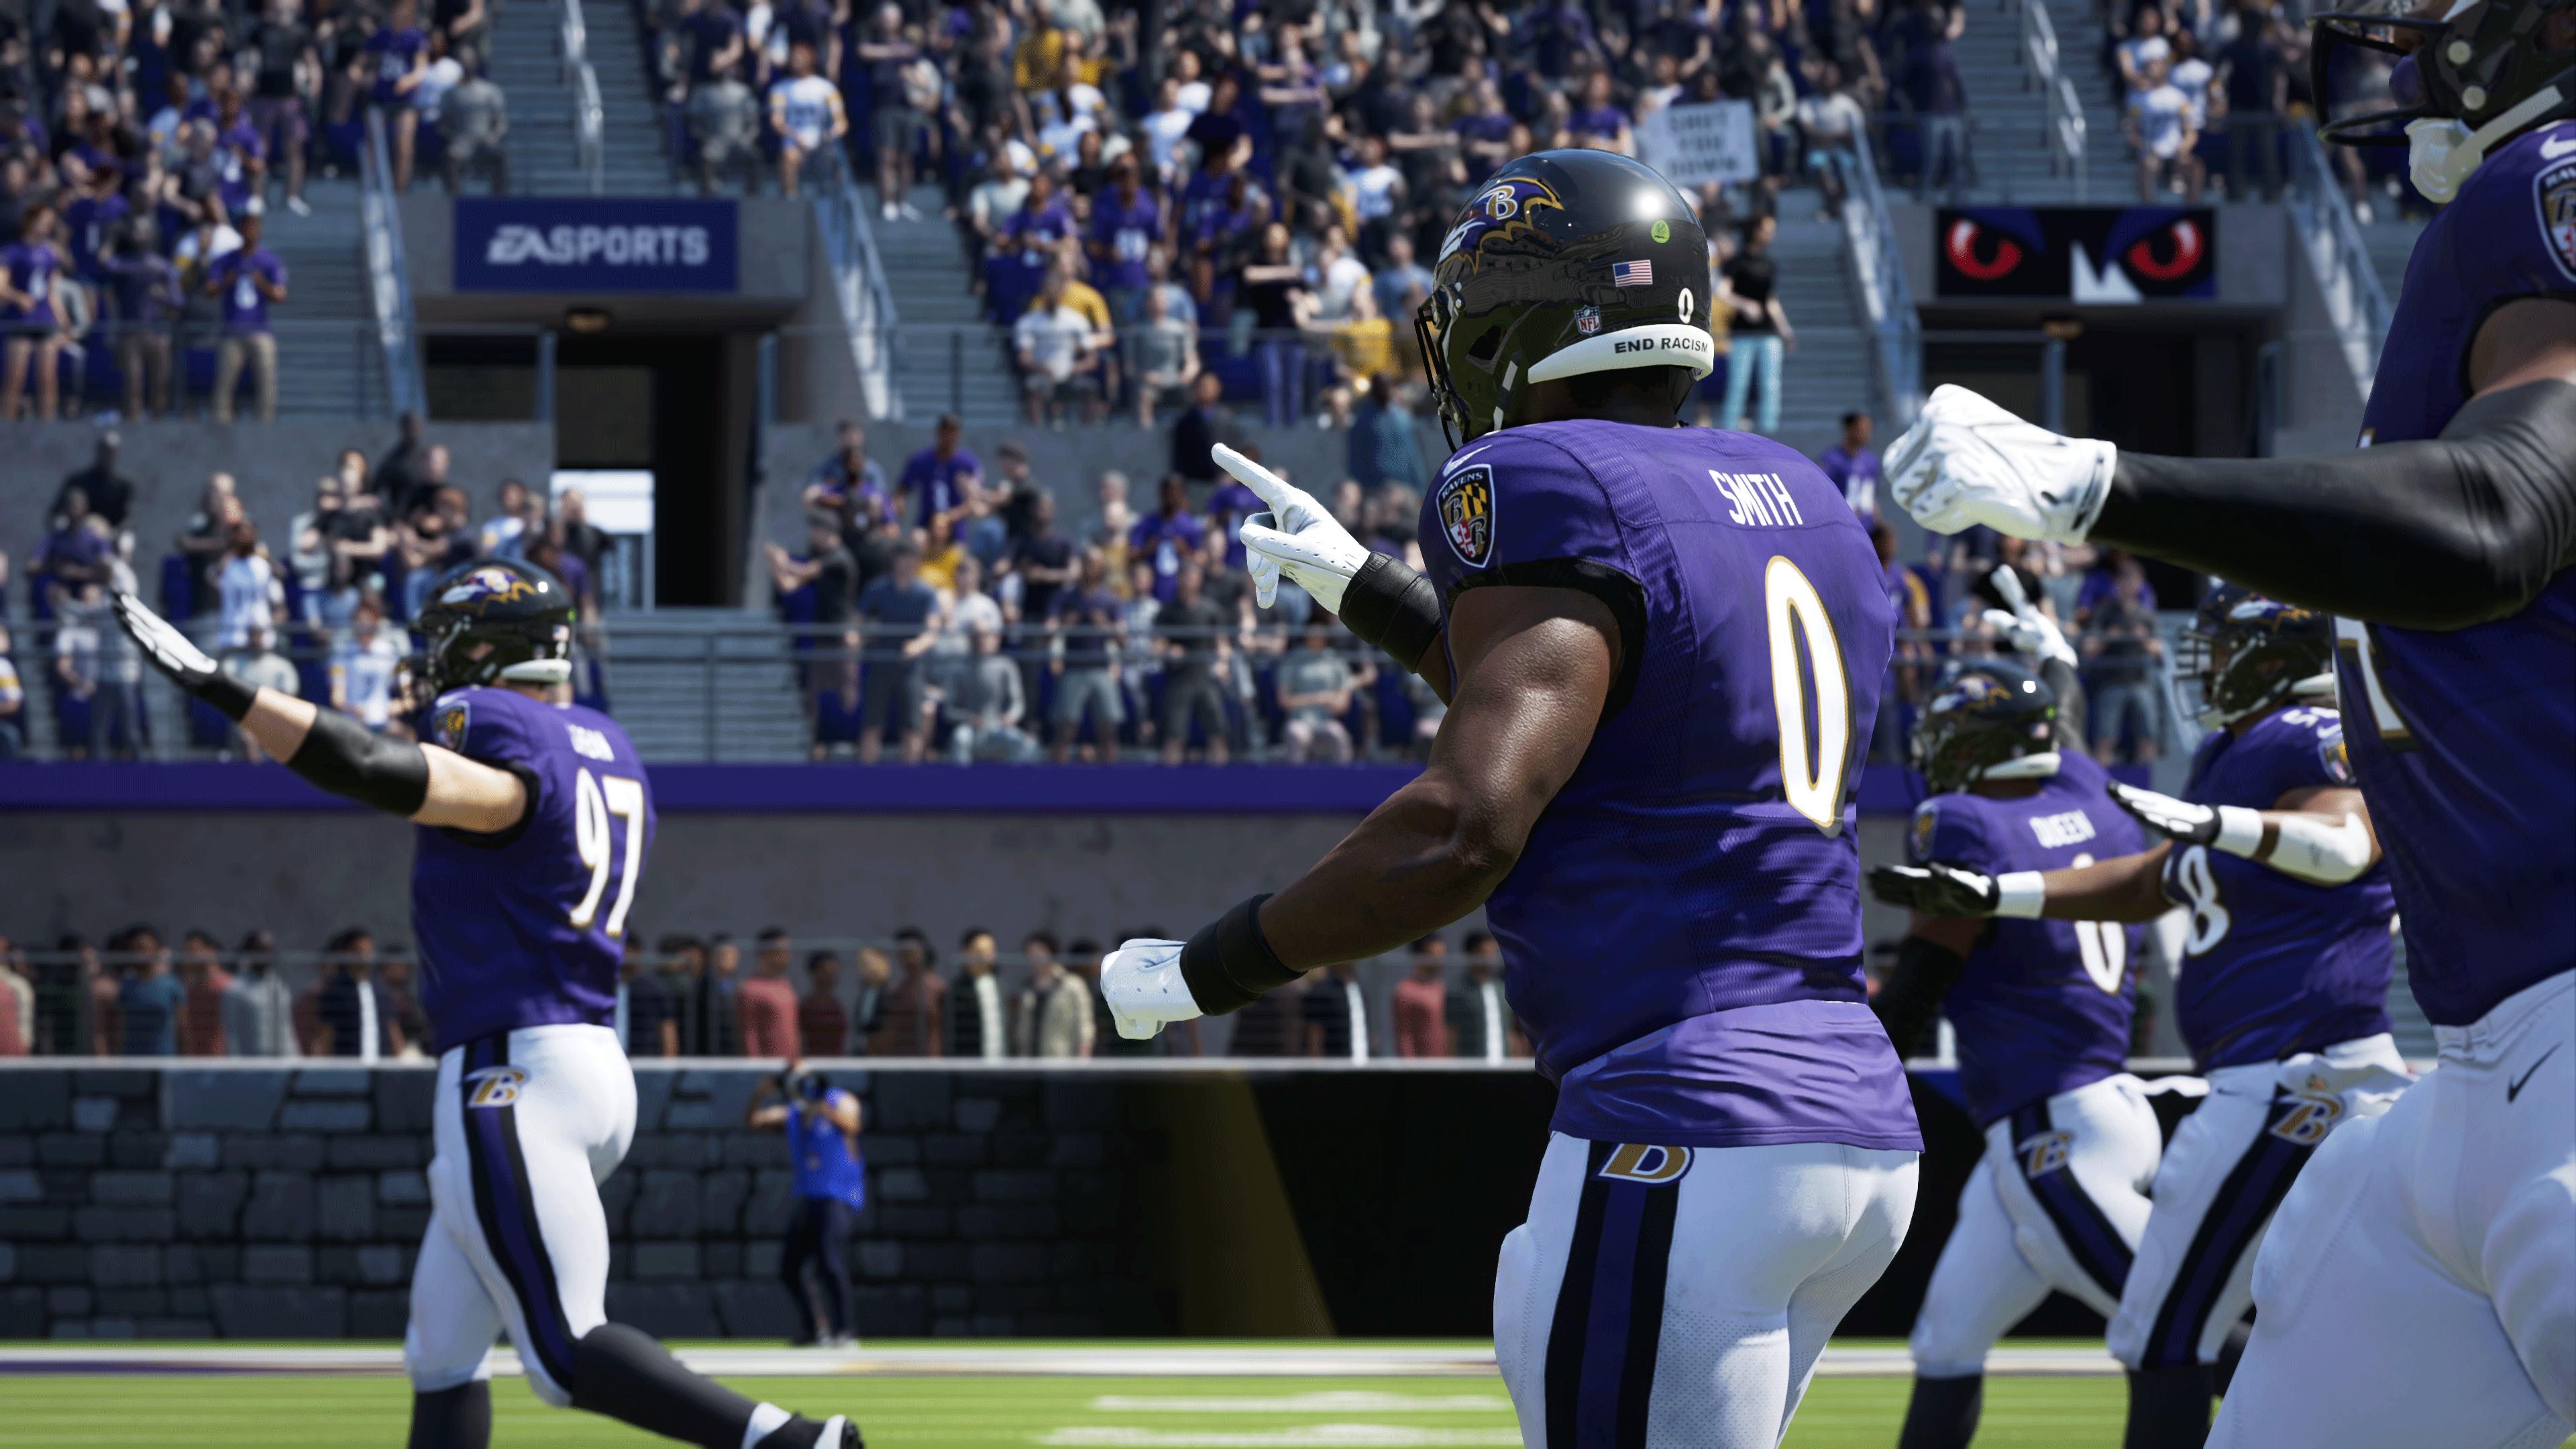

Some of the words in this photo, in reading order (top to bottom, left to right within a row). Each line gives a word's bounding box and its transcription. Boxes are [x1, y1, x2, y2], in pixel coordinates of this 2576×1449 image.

[1678, 287, 1694, 324] 0
[1579, 317, 1600, 332] NFL
[1615, 338, 1654, 354] END
[1661, 337, 1709, 353] RACISM
[1442, 472, 1483, 500] RAVENS
[1709, 469, 1804, 527] SMITH
[1765, 555, 1853, 830] 0
[569, 767, 644, 936] 97
